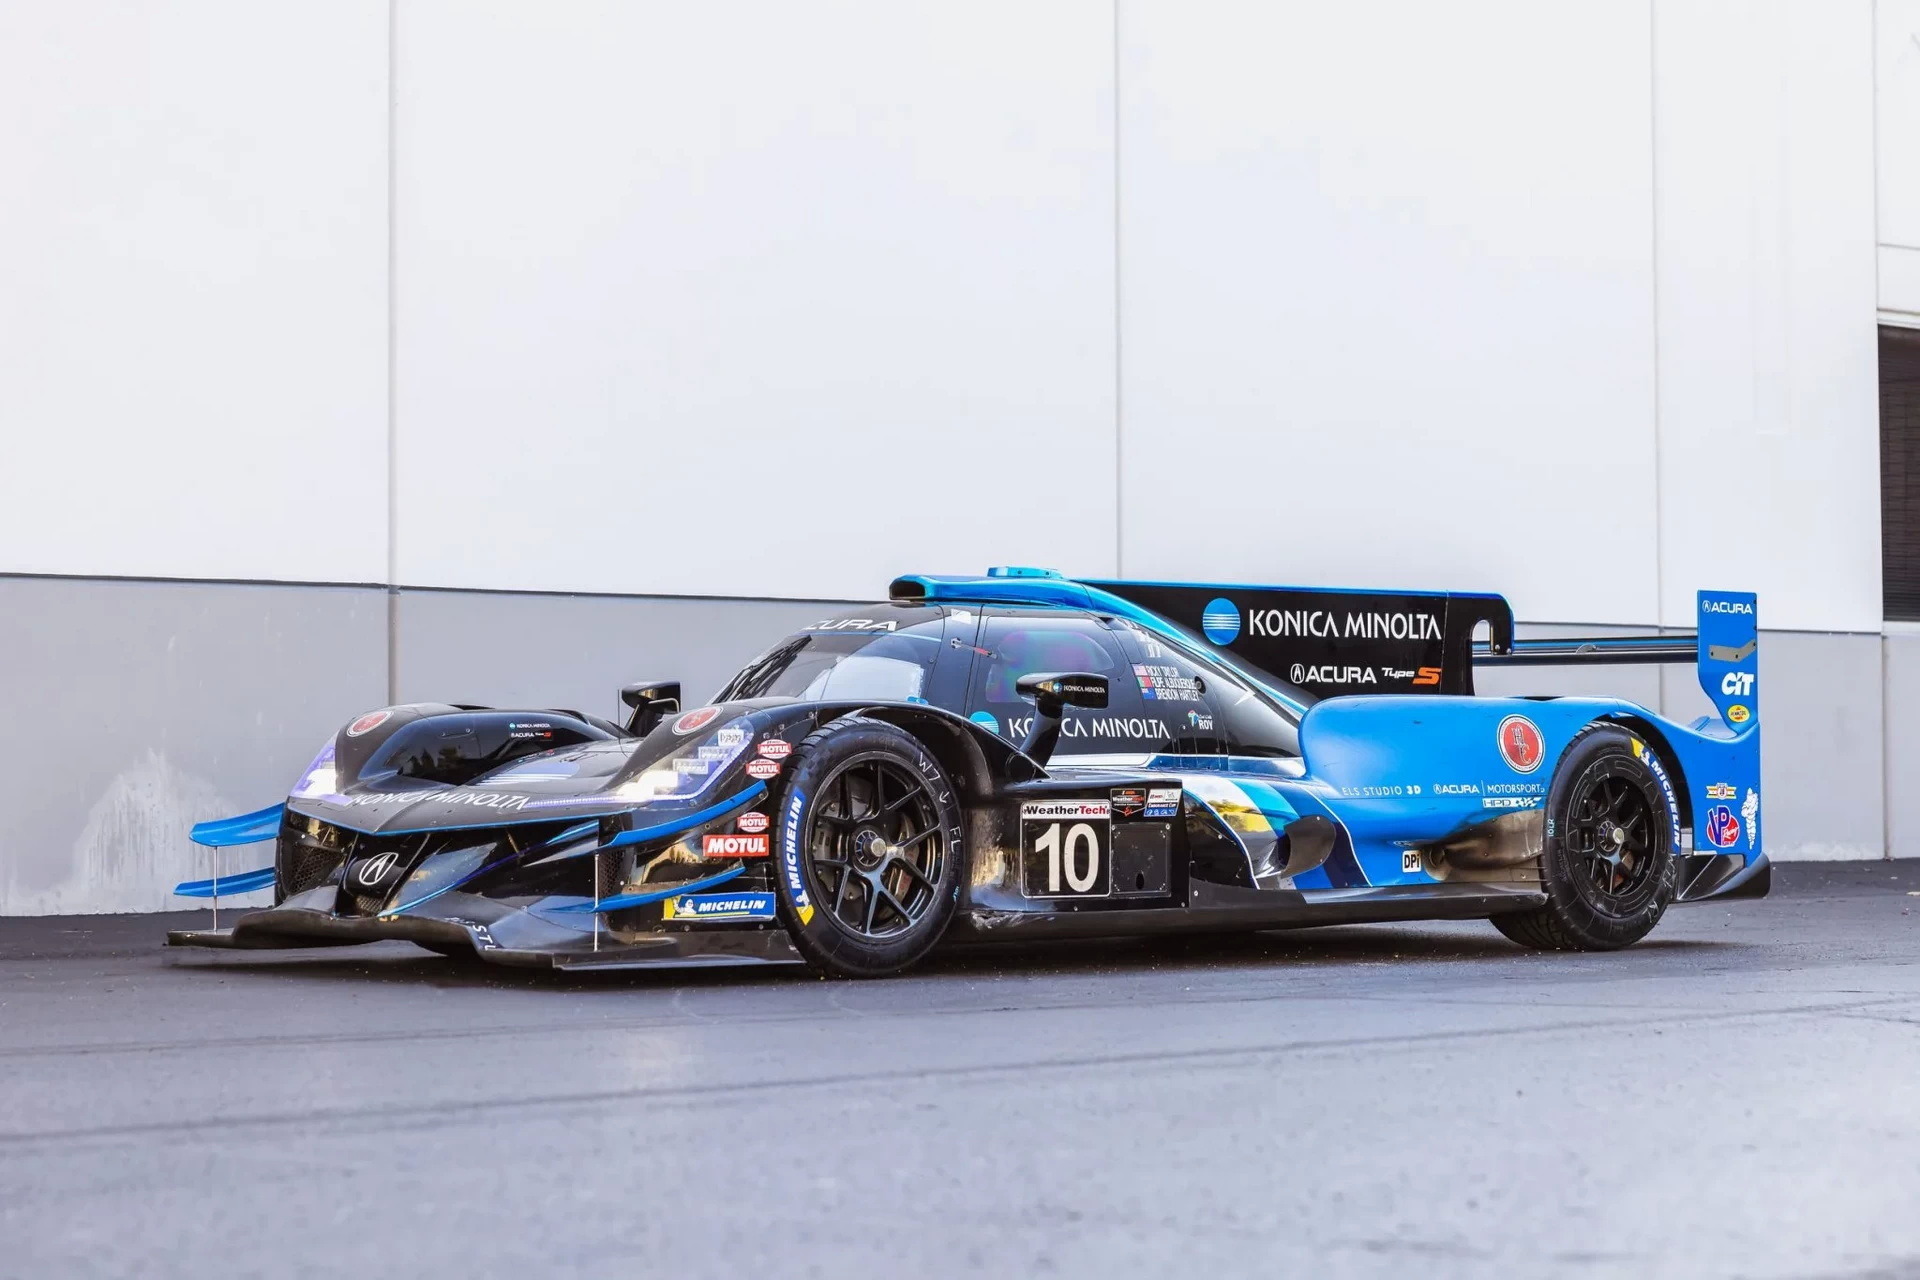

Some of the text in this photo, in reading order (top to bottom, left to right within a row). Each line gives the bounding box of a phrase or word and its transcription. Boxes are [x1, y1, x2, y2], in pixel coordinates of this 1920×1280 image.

[1711, 602, 1753, 614] ACURA
[799, 619, 898, 632] CURA
[1250, 609, 1442, 640] KONICA MINOLTA
[1304, 665, 1442, 685] ACURA Type S
[1084, 686, 1106, 694] MINOLTA
[1092, 718, 1171, 739] MINOLTA
[760, 745, 790, 753] MOTUL
[748, 765, 779, 773] MOTUL
[919, 752, 941, 781] W7
[1342, 785, 1421, 796] ELS STUDIO 3D
[1442, 783, 1541, 794] ACURA MOTORSPORT
[424, 791, 530, 811] MINOLTA
[1651, 760, 1680, 847] MICHELIN
[1026, 805, 1106, 815] WeatherTech
[739, 818, 768, 827] MOTUL
[1708, 805, 1731, 847] VP
[707, 838, 766, 853] MOTUL
[786, 796, 802, 889] MICHELIN
[1035, 823, 1099, 892] 10
[1404, 853, 1420, 869] DPi
[698, 901, 766, 912] MICHELIN
